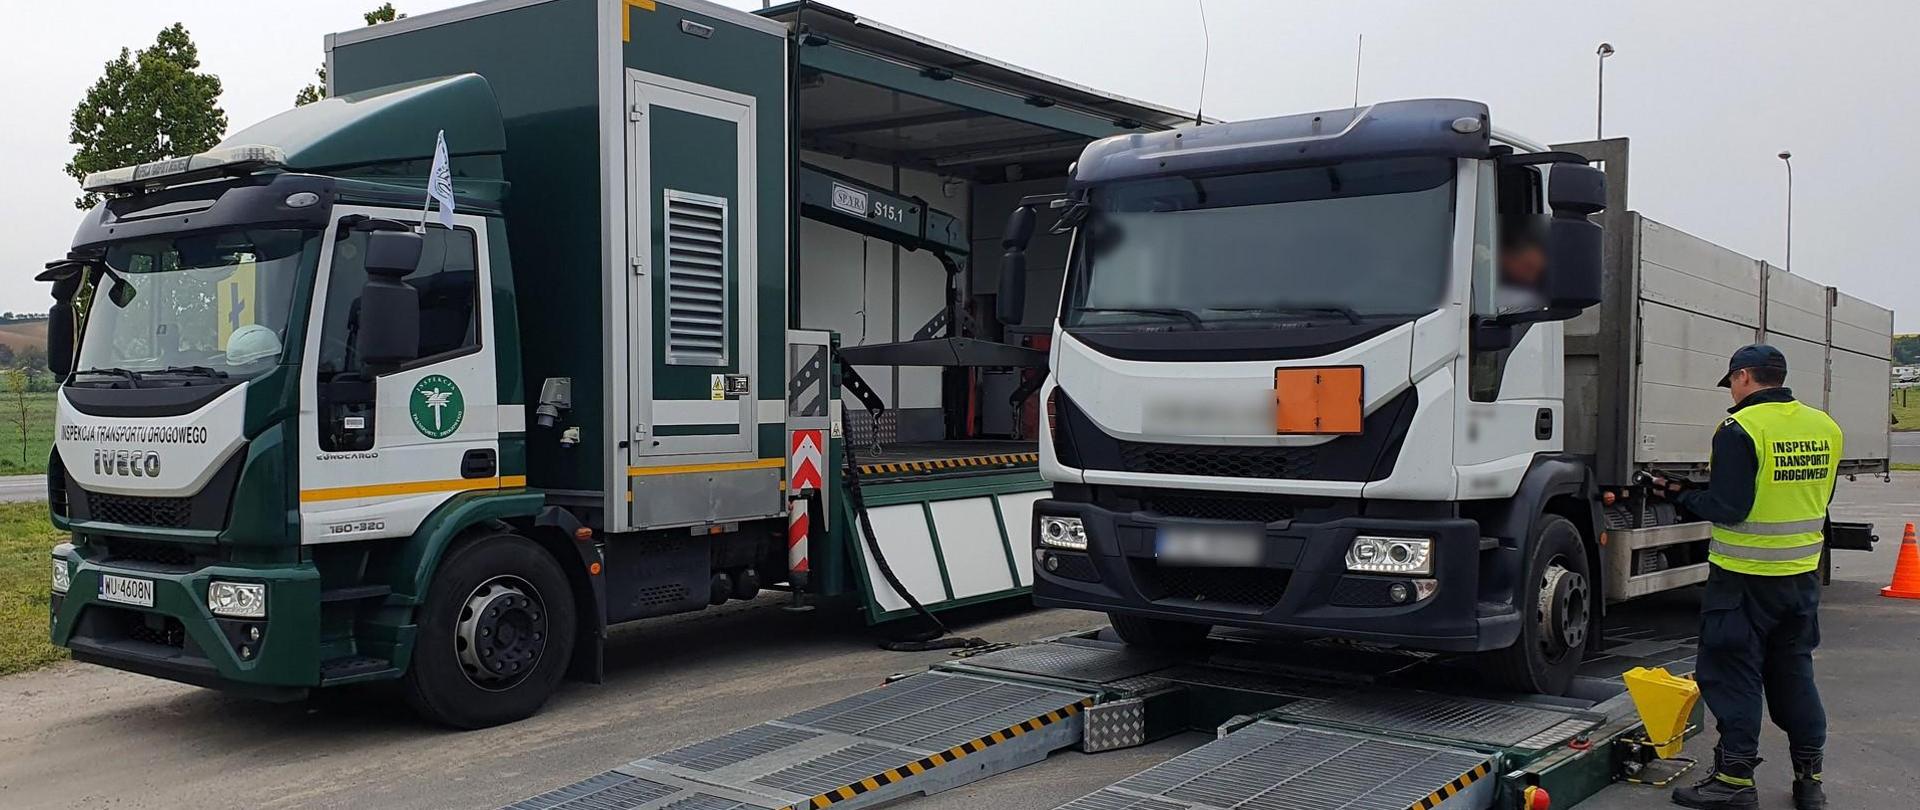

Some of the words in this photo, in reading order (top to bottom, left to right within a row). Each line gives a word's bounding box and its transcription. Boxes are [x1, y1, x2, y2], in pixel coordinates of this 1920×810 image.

[874, 201, 903, 223] S15.1
[61, 425, 95, 441] INSPEKCJA
[95, 426, 147, 443] TRANSPORTU
[149, 426, 207, 444] DROGOWEGO
[1772, 440, 1830, 453] INSPEKCJA
[94, 449, 161, 478] IVECO
[316, 452, 379, 461] EUROCARGO
[1774, 454, 1830, 467] TRANSPORTU
[1774, 467, 1829, 481] DROGOWEGO
